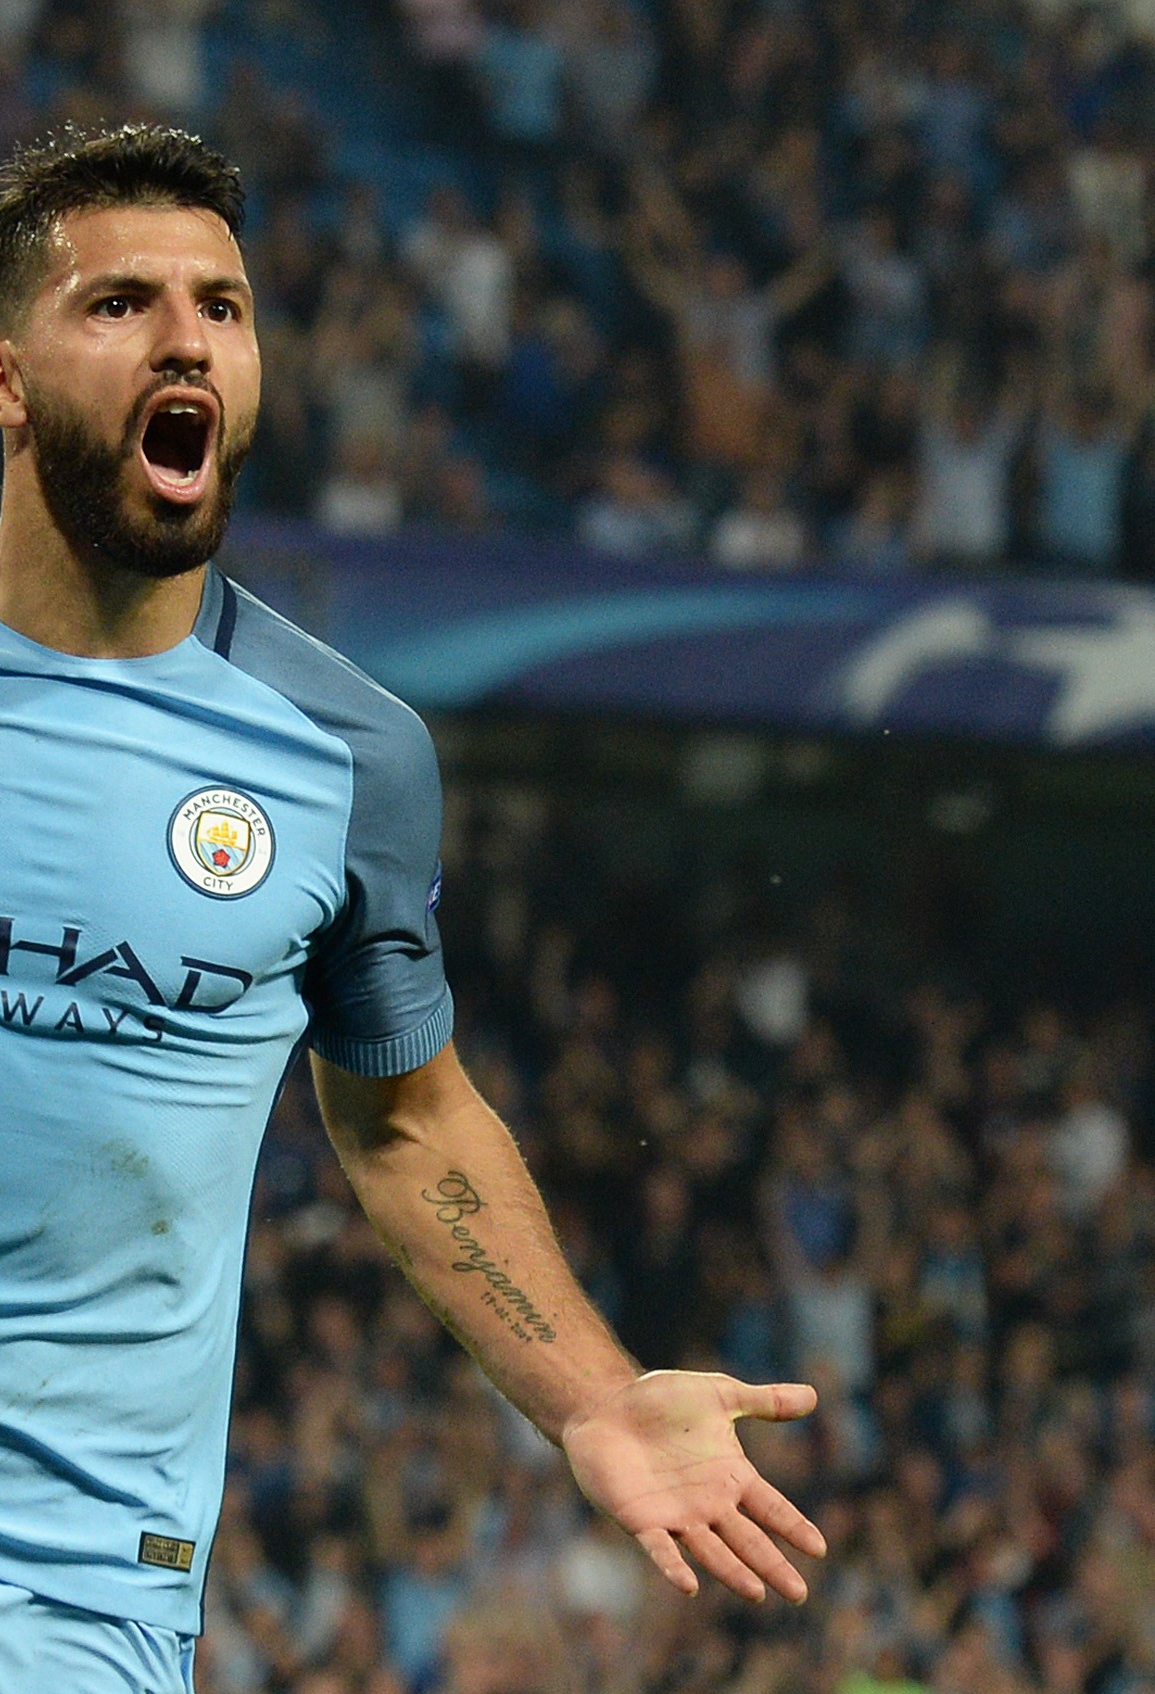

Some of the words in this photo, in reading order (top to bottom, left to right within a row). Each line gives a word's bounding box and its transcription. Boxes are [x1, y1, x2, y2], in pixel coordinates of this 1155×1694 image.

[183, 794, 266, 837] MANCHESTER
[203, 877, 233, 891] CITY
[421, 1170, 557, 1343] Benjamin
